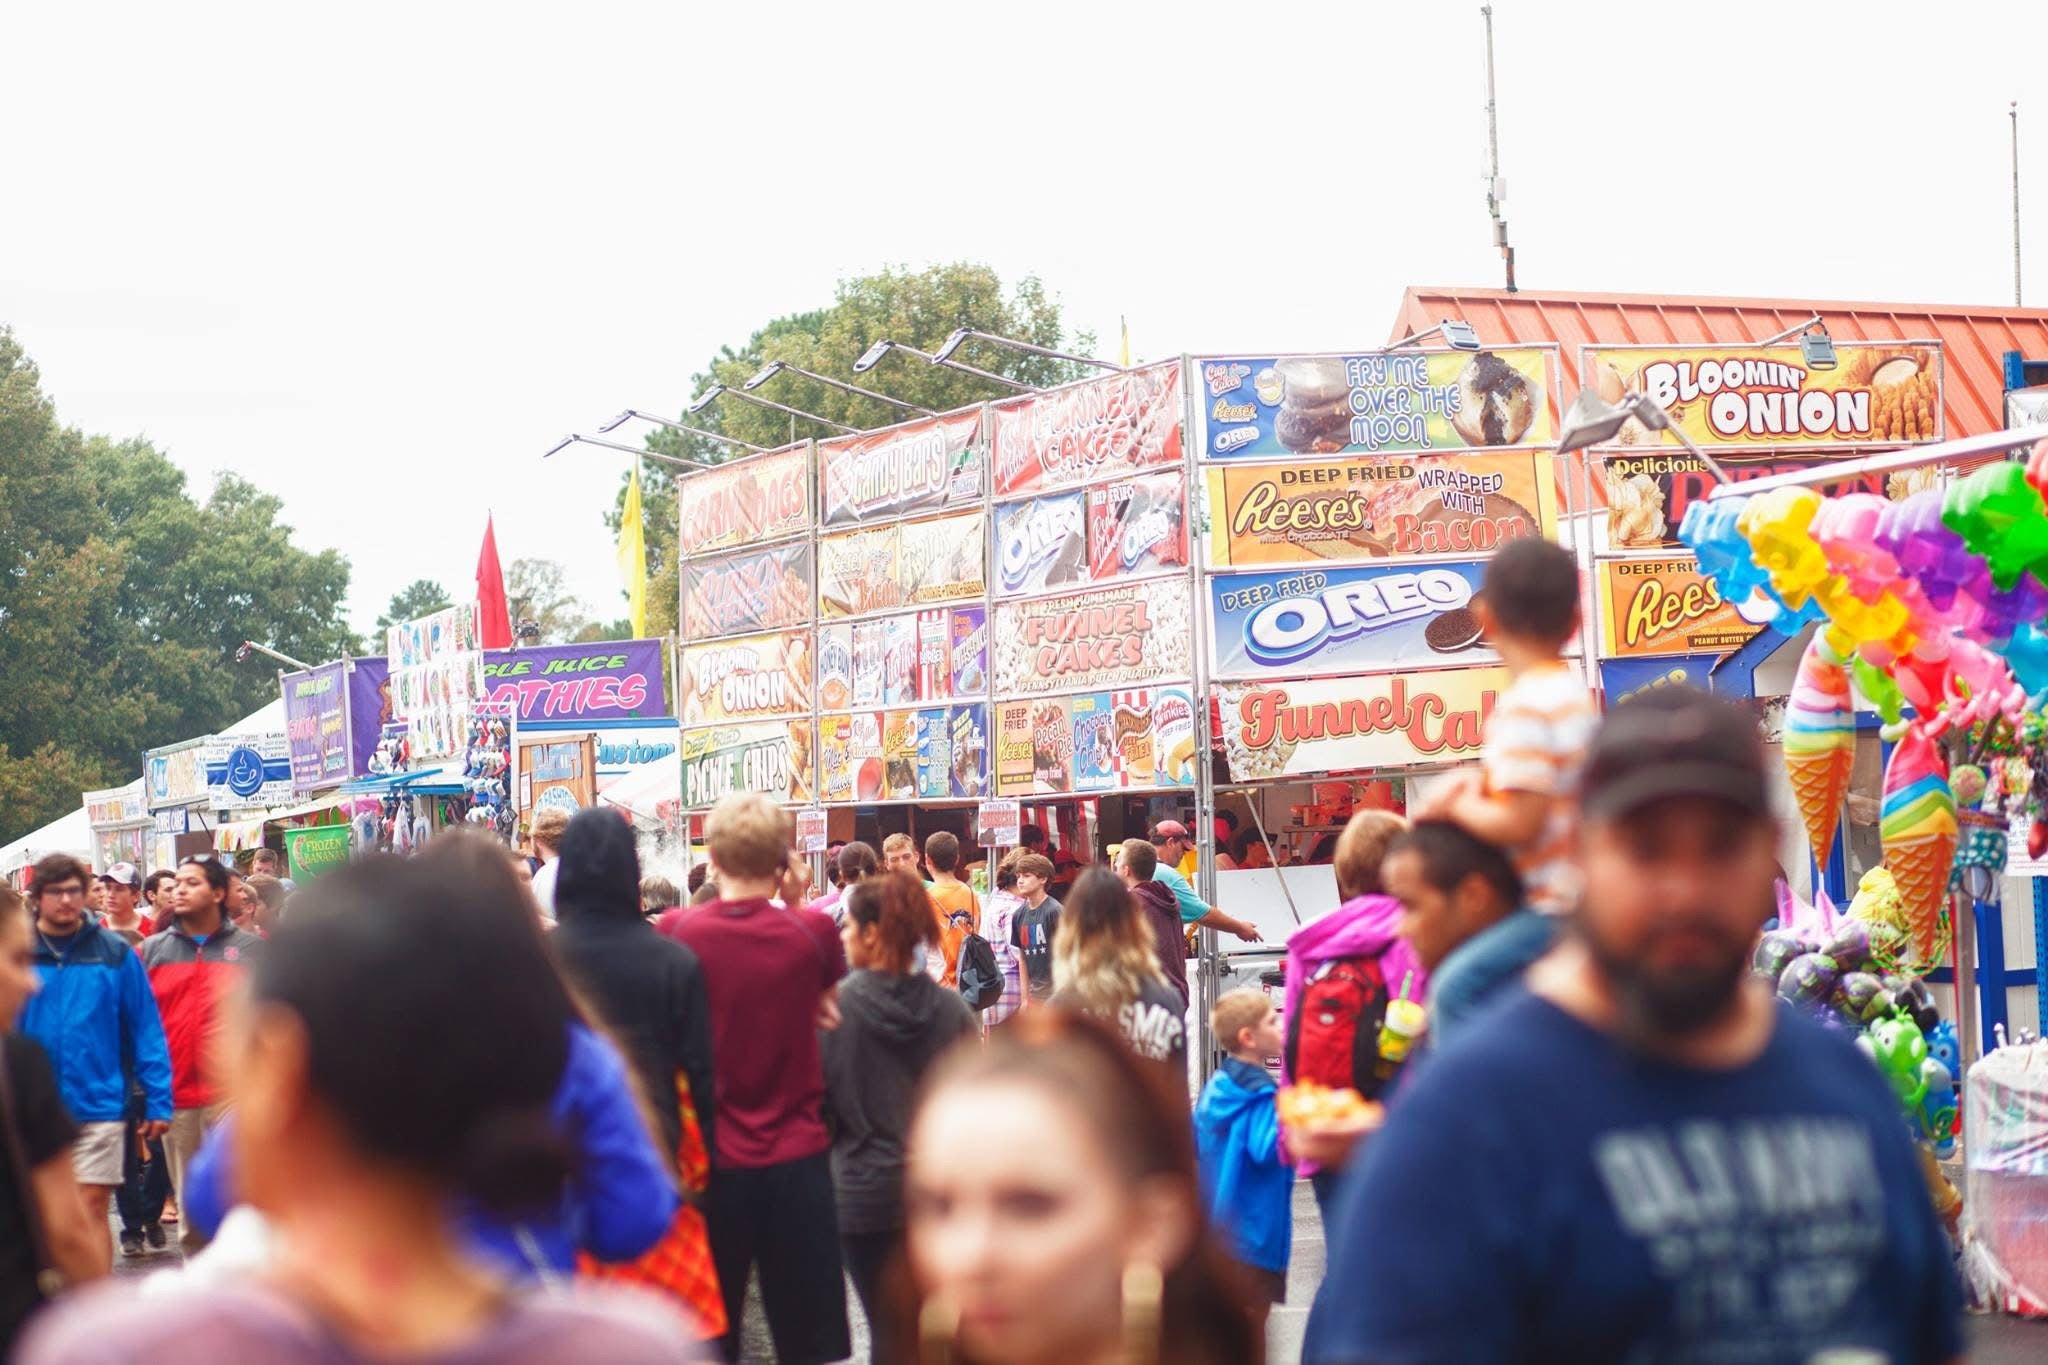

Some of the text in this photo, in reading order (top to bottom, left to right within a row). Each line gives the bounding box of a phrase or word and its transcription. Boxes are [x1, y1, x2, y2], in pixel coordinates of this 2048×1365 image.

[1346, 357, 1430, 393] FRY ME
[1644, 360, 1806, 409] BLOOMIN'
[1349, 384, 1461, 419] OVER THE
[1710, 391, 1870, 434] ONION
[1350, 414, 1431, 450] MOON
[902, 428, 945, 492] Bars
[1281, 465, 1415, 485] DEEP FRIED
[1614, 457, 1710, 475] Delicious
[1419, 469, 1504, 494] WRAPPED
[1233, 481, 1370, 536] Reese's
[1441, 490, 1486, 514] WITH
[1393, 513, 1527, 553] Bacon
[1619, 563, 1663, 576] DEEP
[1077, 588, 1136, 607] HOMEMADE
[1221, 573, 1327, 612] DEEP FRIED
[1027, 601, 1152, 646] FUNNEL
[1247, 569, 1472, 655] OREO
[1037, 634, 1142, 677] CAKES
[1694, 635, 1718, 645] PEANUT
[540, 654, 629, 676] JUICE
[1021, 667, 1163, 692] PENNSYLVANIA DUTCH QUALITY
[722, 670, 787, 712] ONION
[1004, 719, 1028, 731] FRIED
[1006, 708, 1027, 719] DEEP
[1240, 680, 1409, 749] Funnel
[266, 732, 286, 740] Latte
[685, 728, 741, 755] DEEP FRIED
[1035, 717, 1065, 749] Pecan
[1057, 733, 1073, 760] Pie
[1074, 711, 1112, 752] Chocolate
[686, 741, 788, 806] PICKLE CHIPS
[306, 839, 342, 852] FROZEN
